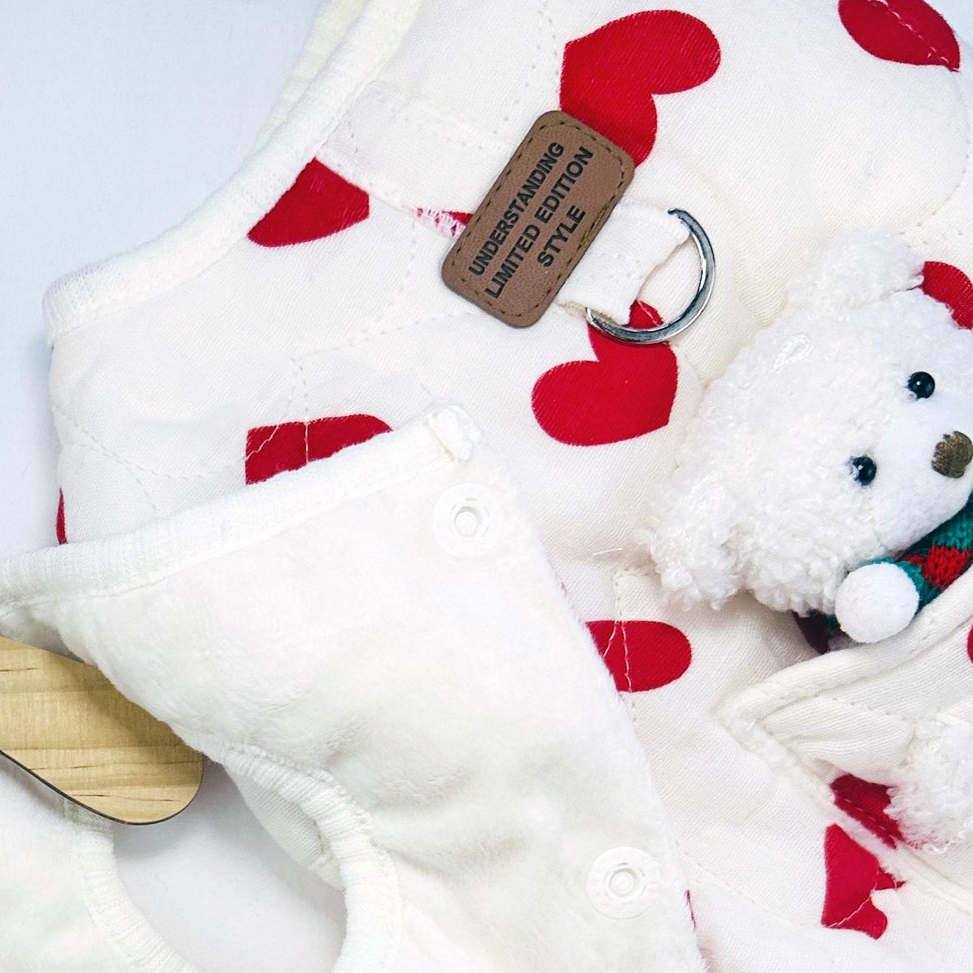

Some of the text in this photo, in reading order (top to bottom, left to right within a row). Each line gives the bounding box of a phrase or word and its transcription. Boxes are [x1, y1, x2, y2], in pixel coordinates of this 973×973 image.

[468, 142, 565, 276] UNDERSTANDING
[484, 146, 594, 299] LIMITED EDITION
[537, 205, 586, 268] STYLE
